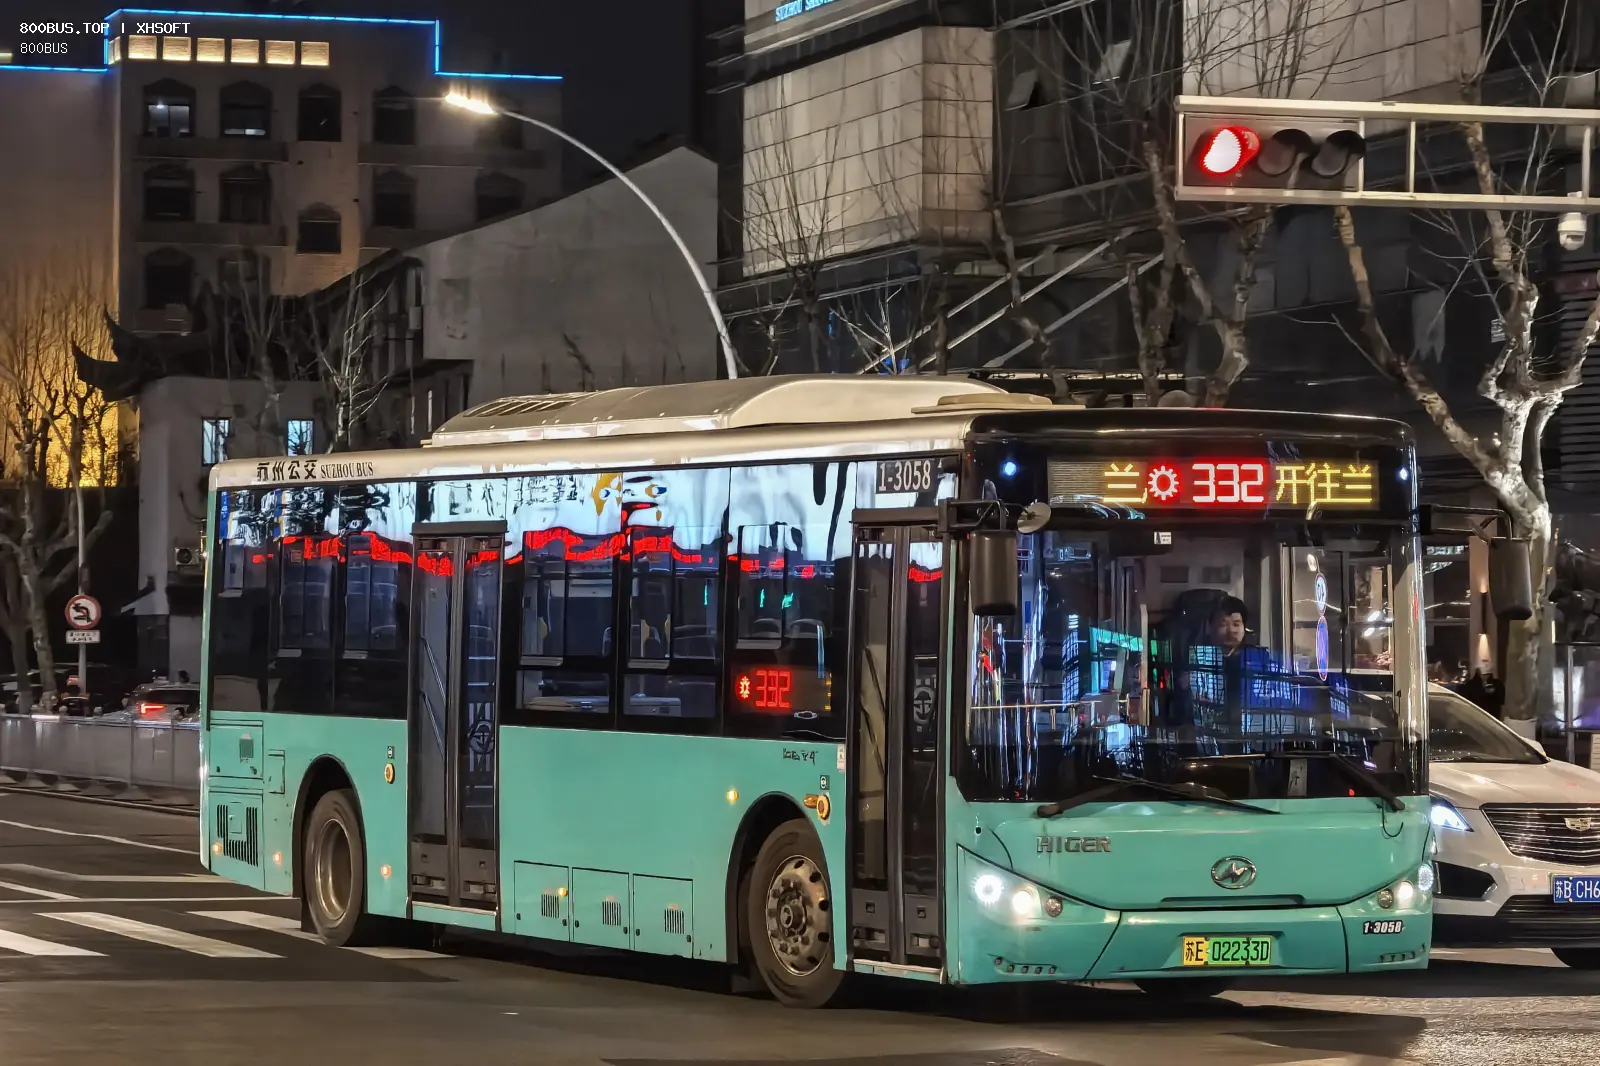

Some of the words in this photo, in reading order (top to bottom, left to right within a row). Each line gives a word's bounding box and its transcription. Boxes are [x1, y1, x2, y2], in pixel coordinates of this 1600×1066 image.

[320, 463, 355, 479] SUZHOU
[356, 461, 374, 477] BUS
[878, 460, 931, 492] 1-3058
[1192, 463, 1265, 503] 332
[1275, 462, 1373, 504] 开往兰
[755, 670, 791, 708] 332
[1036, 836, 1112, 853] HIGER
